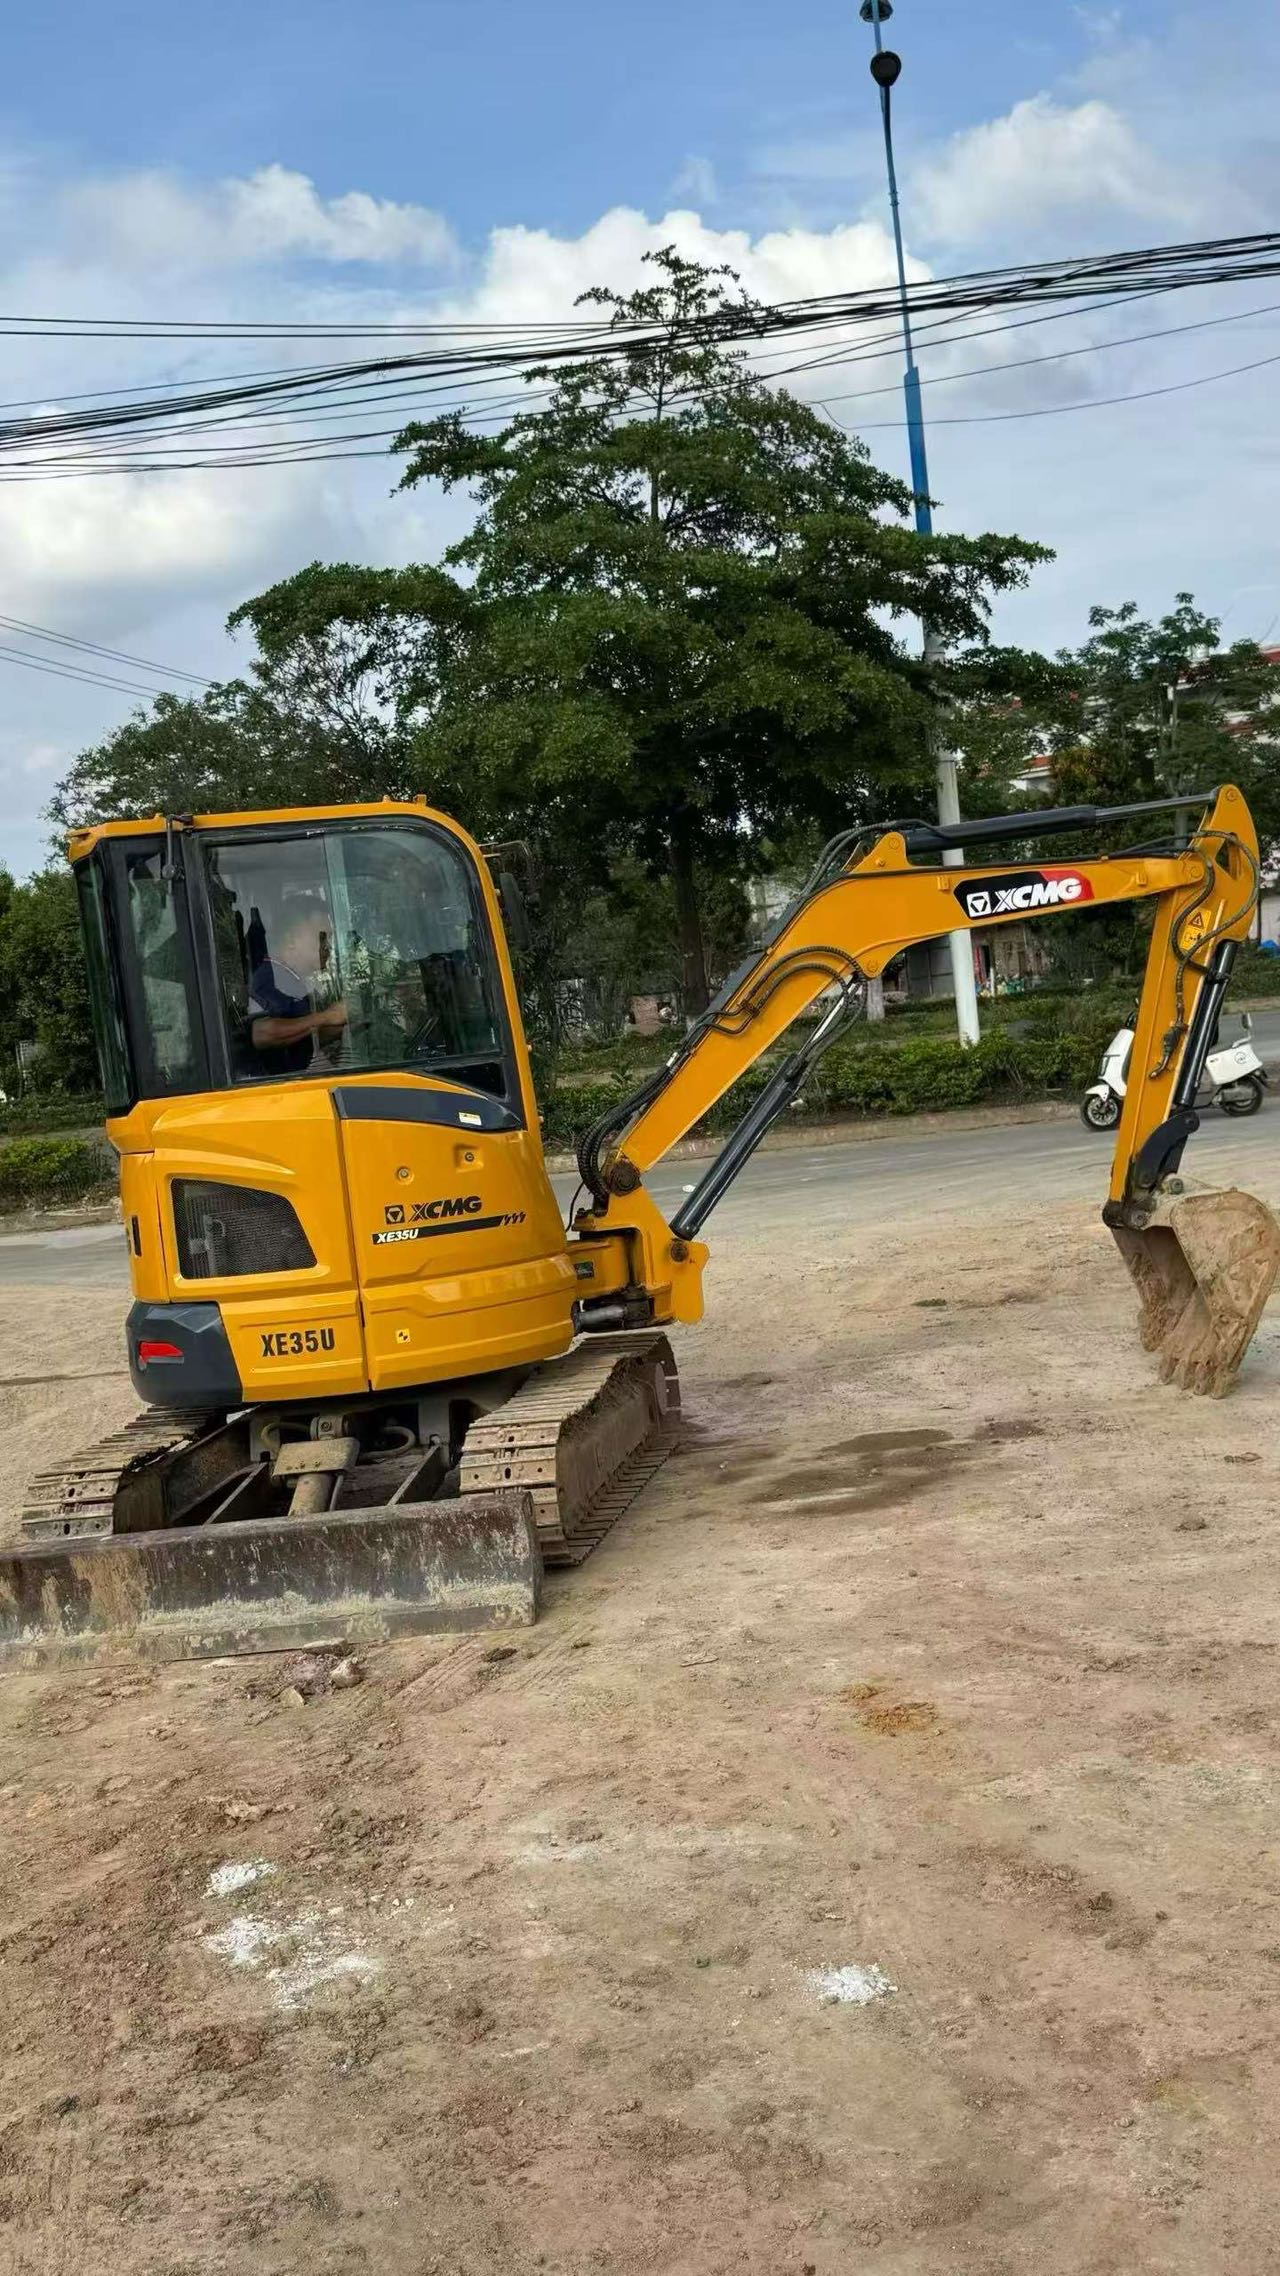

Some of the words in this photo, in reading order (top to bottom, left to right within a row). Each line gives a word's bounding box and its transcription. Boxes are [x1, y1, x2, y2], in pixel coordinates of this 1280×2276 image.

[991, 877, 1083, 914] XCMG
[408, 1195, 482, 1223] XCMG
[376, 1228, 419, 1244] XE35U
[260, 1327, 335, 1357] XE35U
